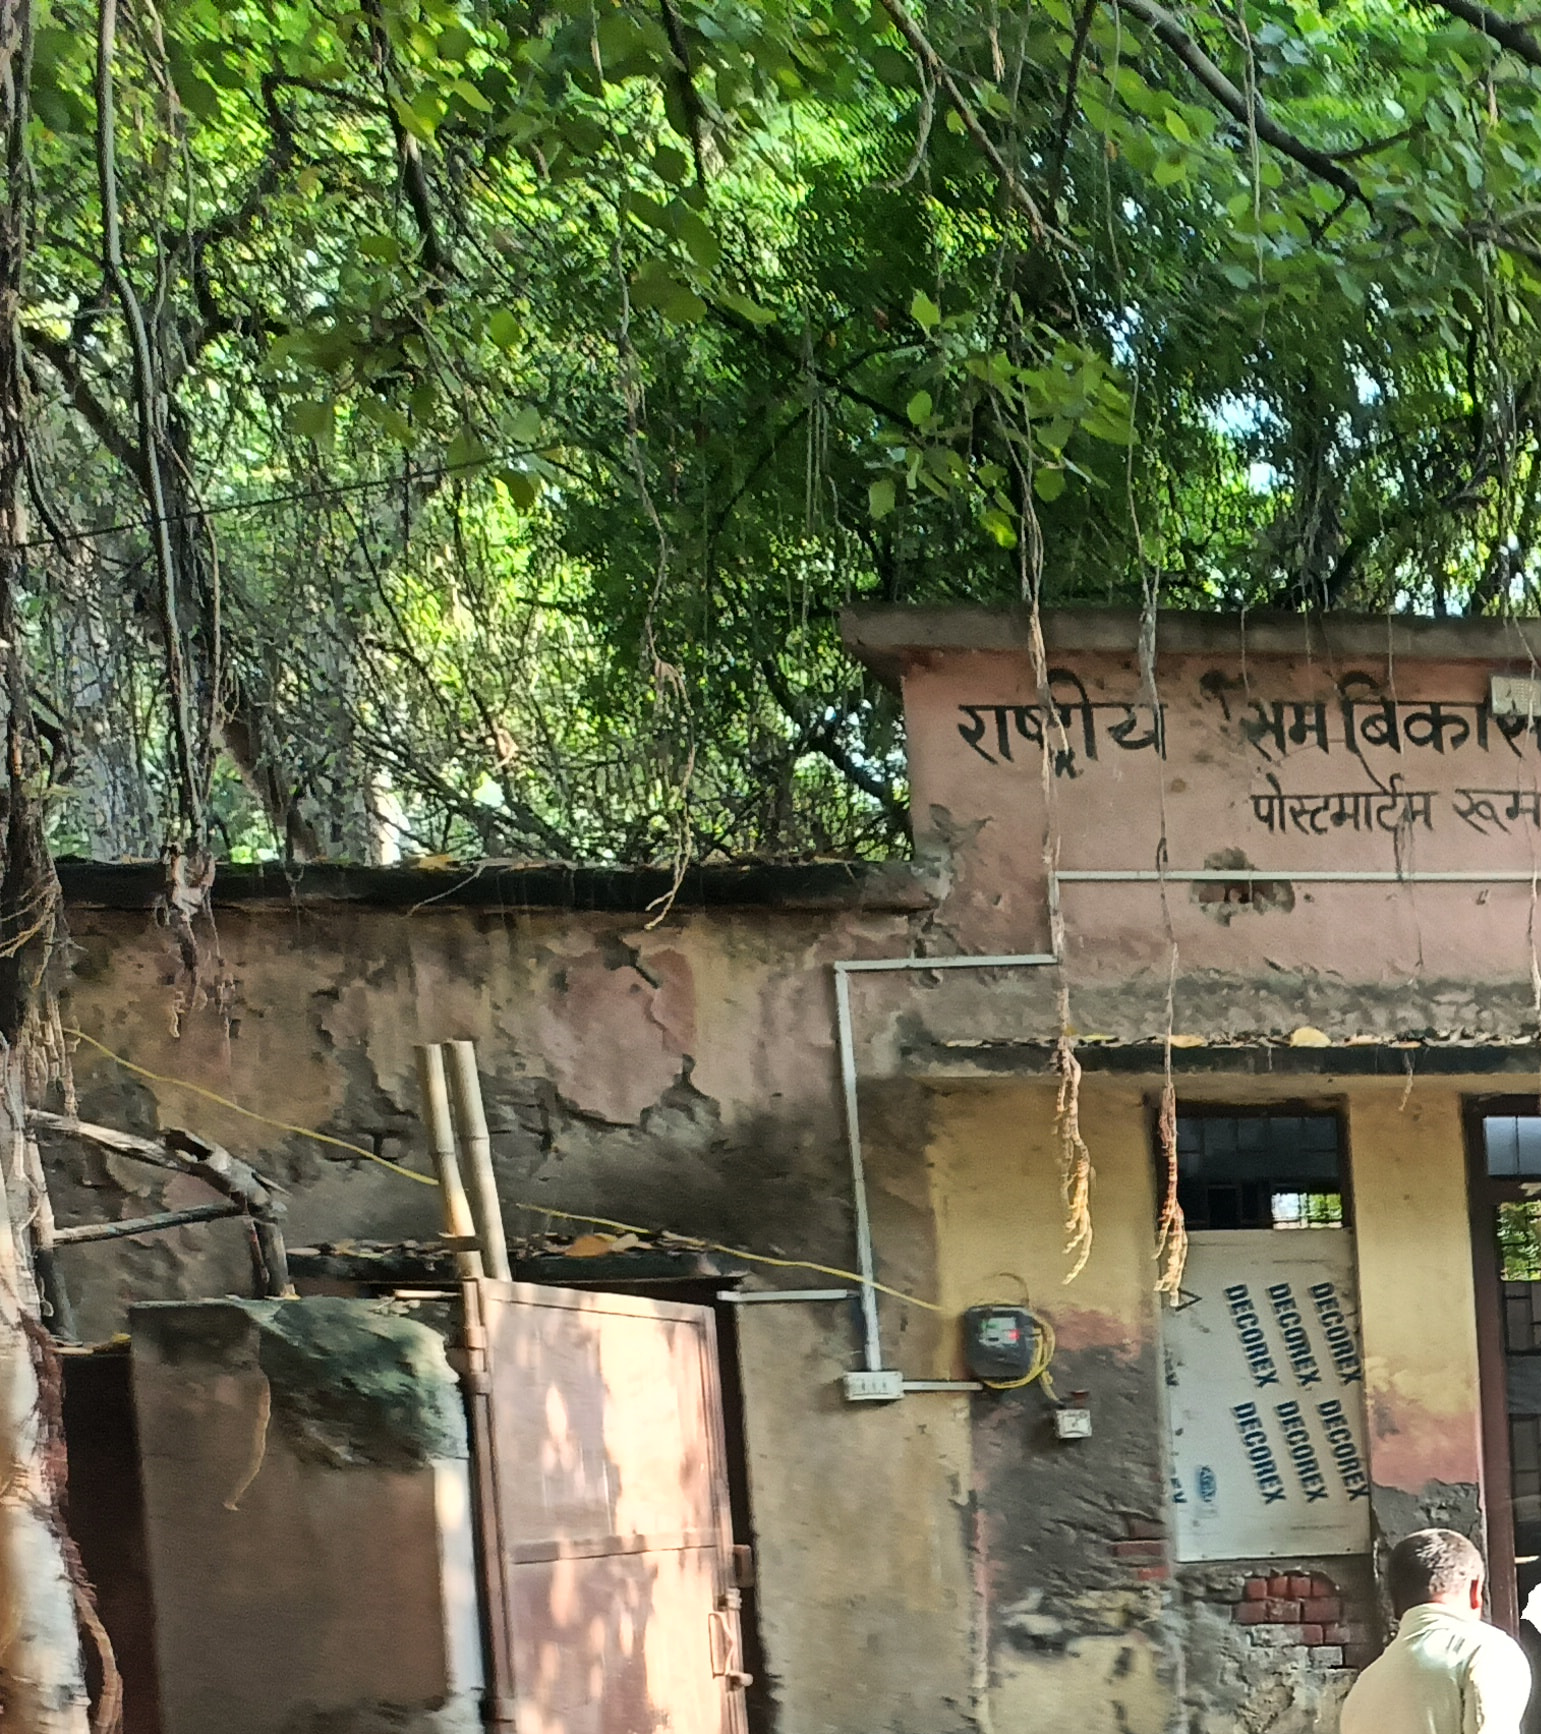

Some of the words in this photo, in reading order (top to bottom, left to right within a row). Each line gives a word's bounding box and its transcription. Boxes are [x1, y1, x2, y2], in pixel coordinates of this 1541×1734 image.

[1223, 1283, 1279, 1388] DECOREX
[1265, 1282, 1322, 1387] DECOREX
[1307, 1281, 1362, 1386] DECOREX
[1229, 1401, 1287, 1504] DECOREX
[1273, 1399, 1329, 1504] DECOREX
[1315, 1399, 1370, 1502] DECOREX
